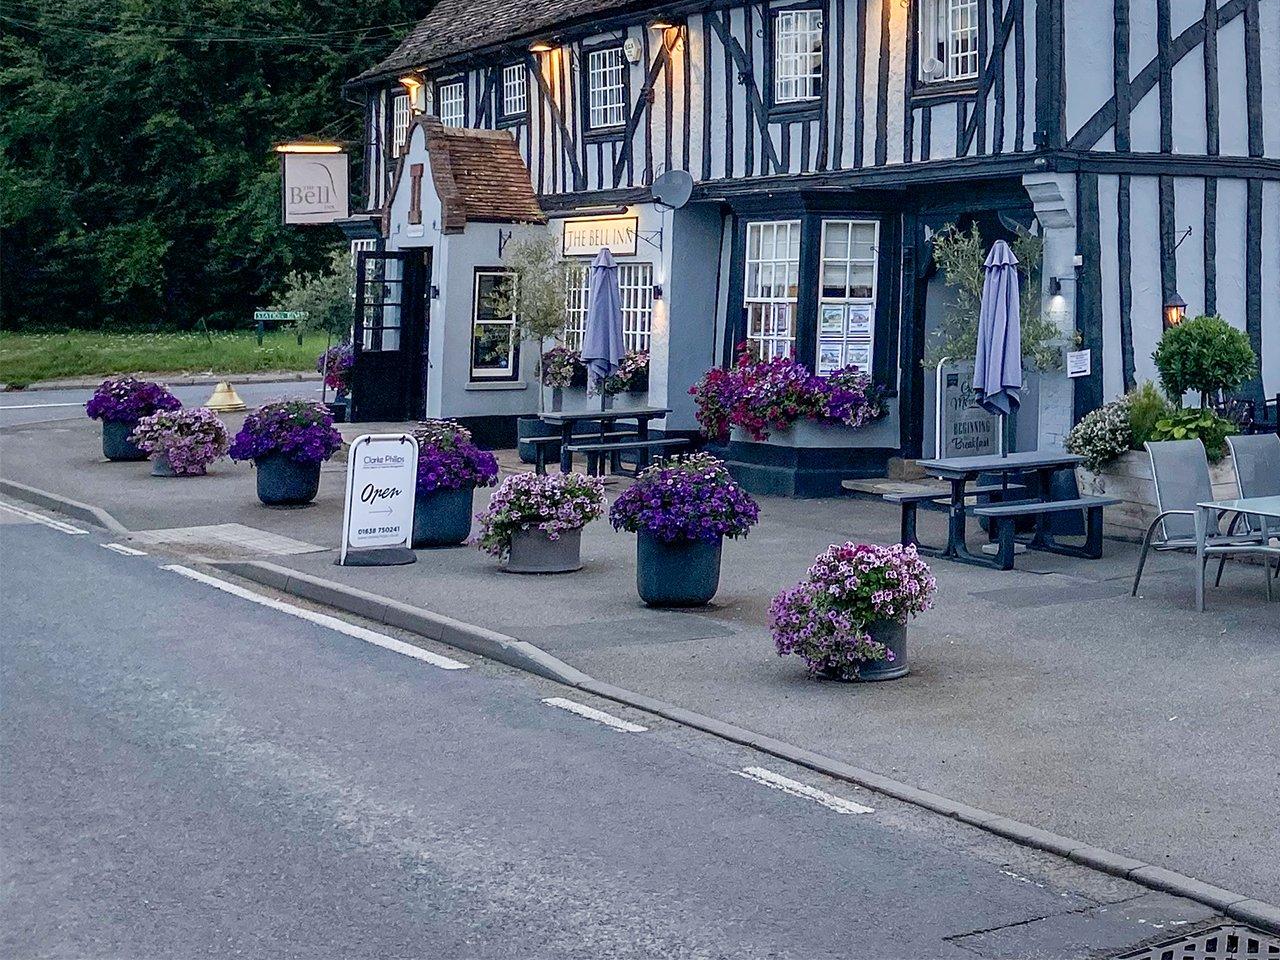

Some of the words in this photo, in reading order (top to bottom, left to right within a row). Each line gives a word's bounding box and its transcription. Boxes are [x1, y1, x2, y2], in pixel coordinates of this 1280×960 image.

[290, 186, 331, 205] Bell
[568, 230, 586, 248] THE
[589, 229, 609, 246] BELL
[613, 227, 633, 245] INN
[361, 483, 402, 505] Open
